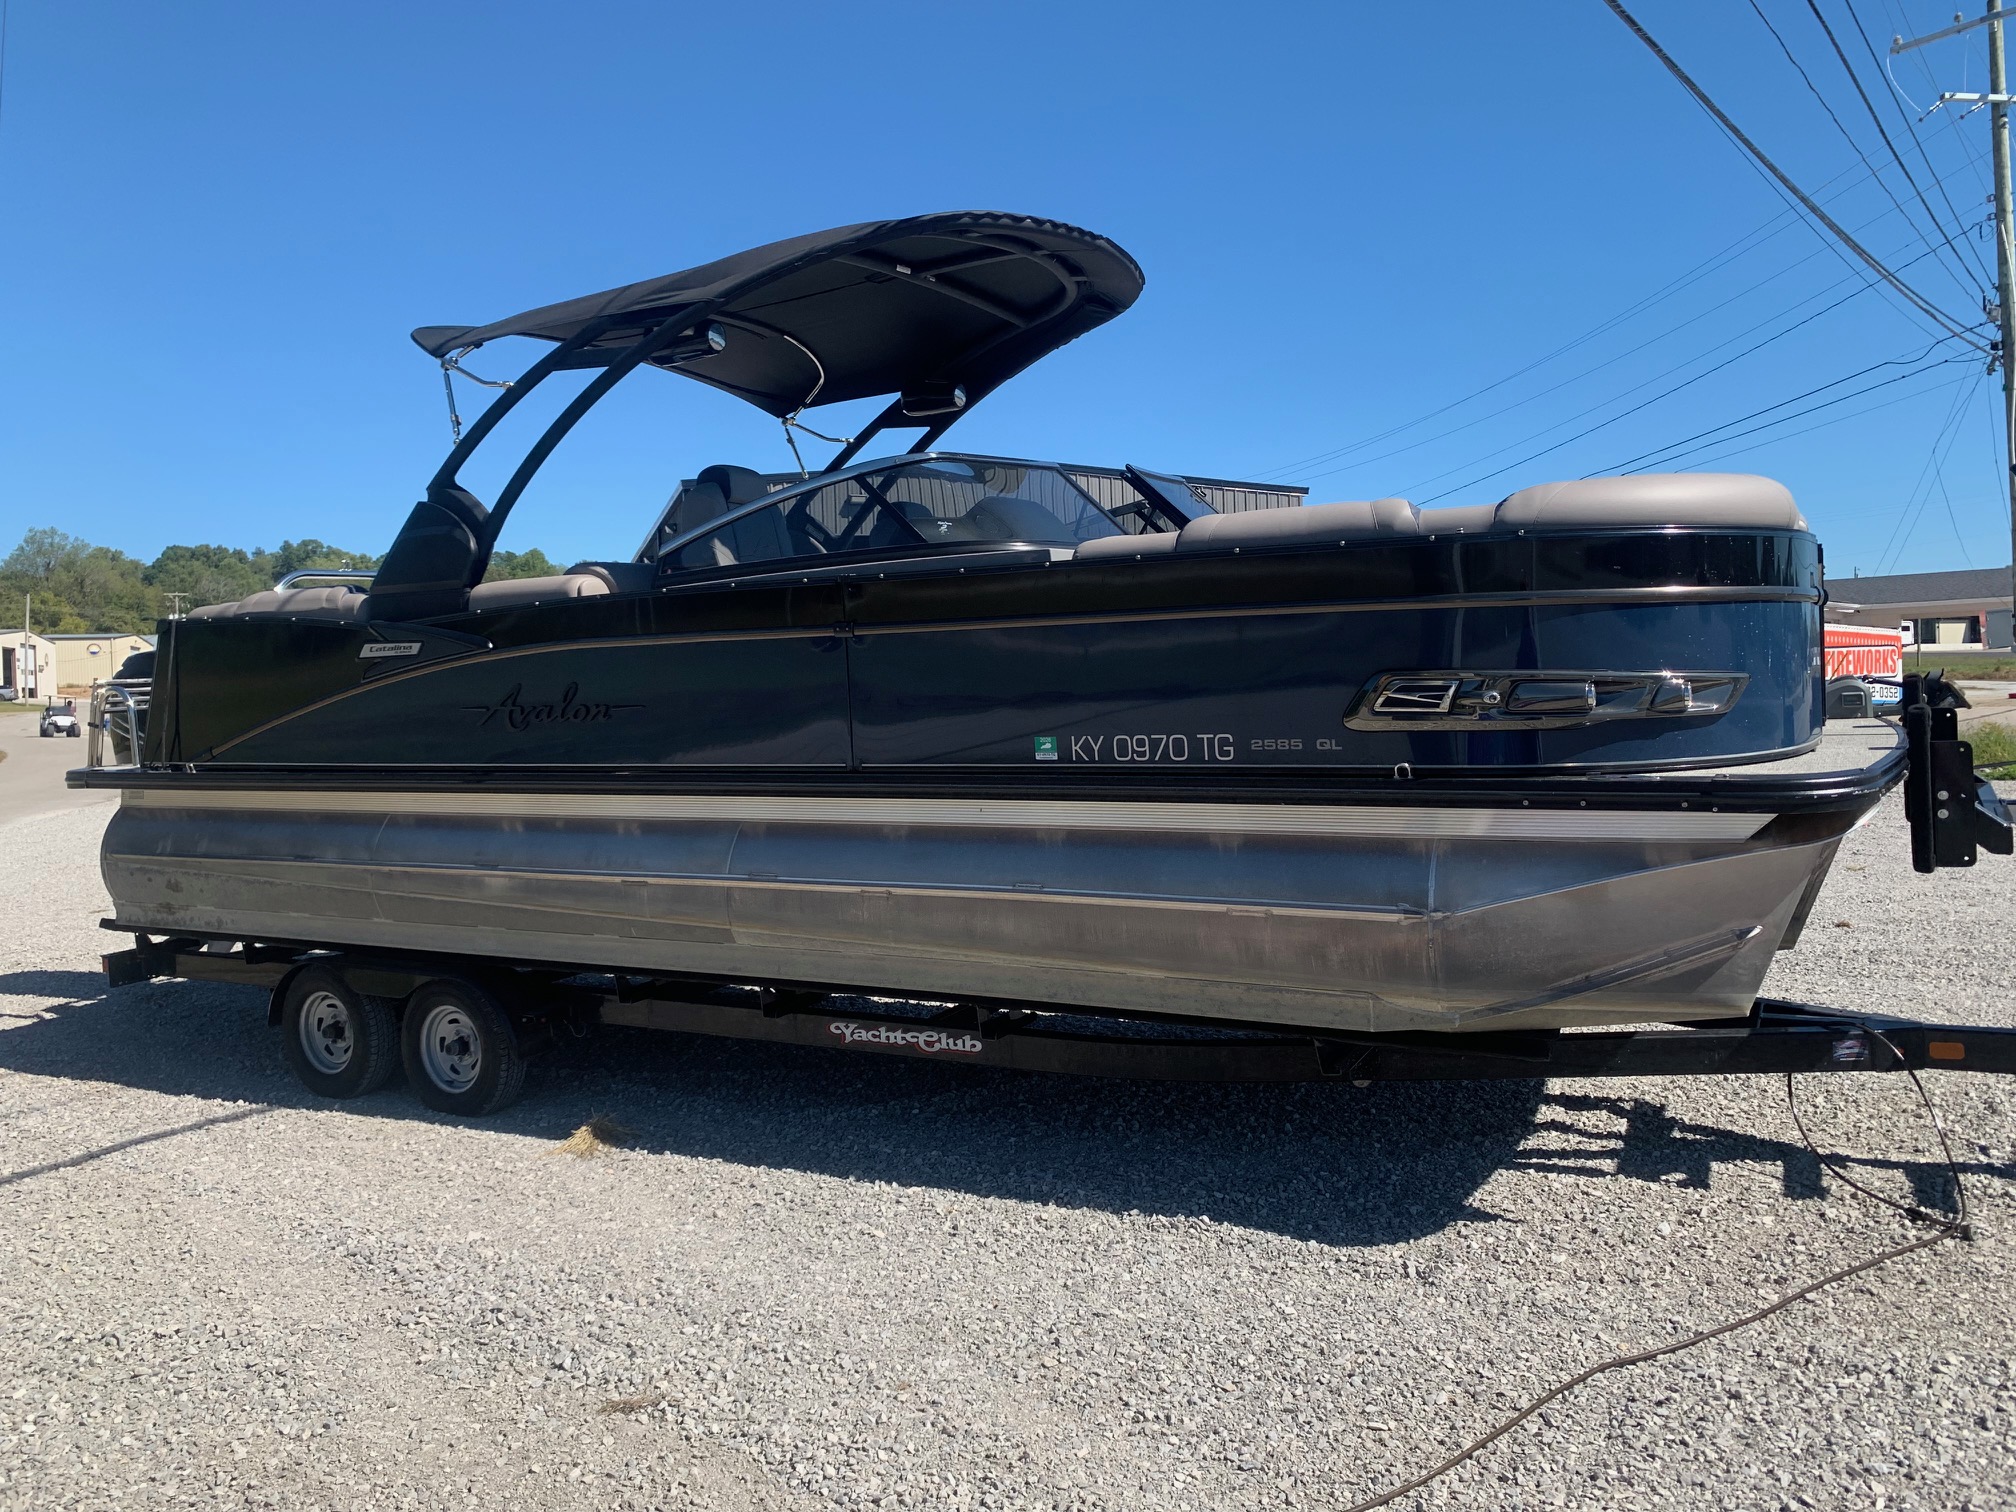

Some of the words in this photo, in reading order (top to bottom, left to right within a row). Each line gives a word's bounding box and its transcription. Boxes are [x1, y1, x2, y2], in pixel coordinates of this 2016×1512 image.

[369, 644, 413, 653] Catalina
[1825, 649, 1898, 677] FIREWORKS
[1868, 686, 1898, 698] 2-0352
[459, 681, 646, 732] Avalon
[1071, 735, 1104, 761] KY
[1113, 734, 1188, 761] 0970
[1197, 733, 1234, 761] TG
[1251, 739, 1303, 750] 2585
[1316, 738, 1342, 750] QL
